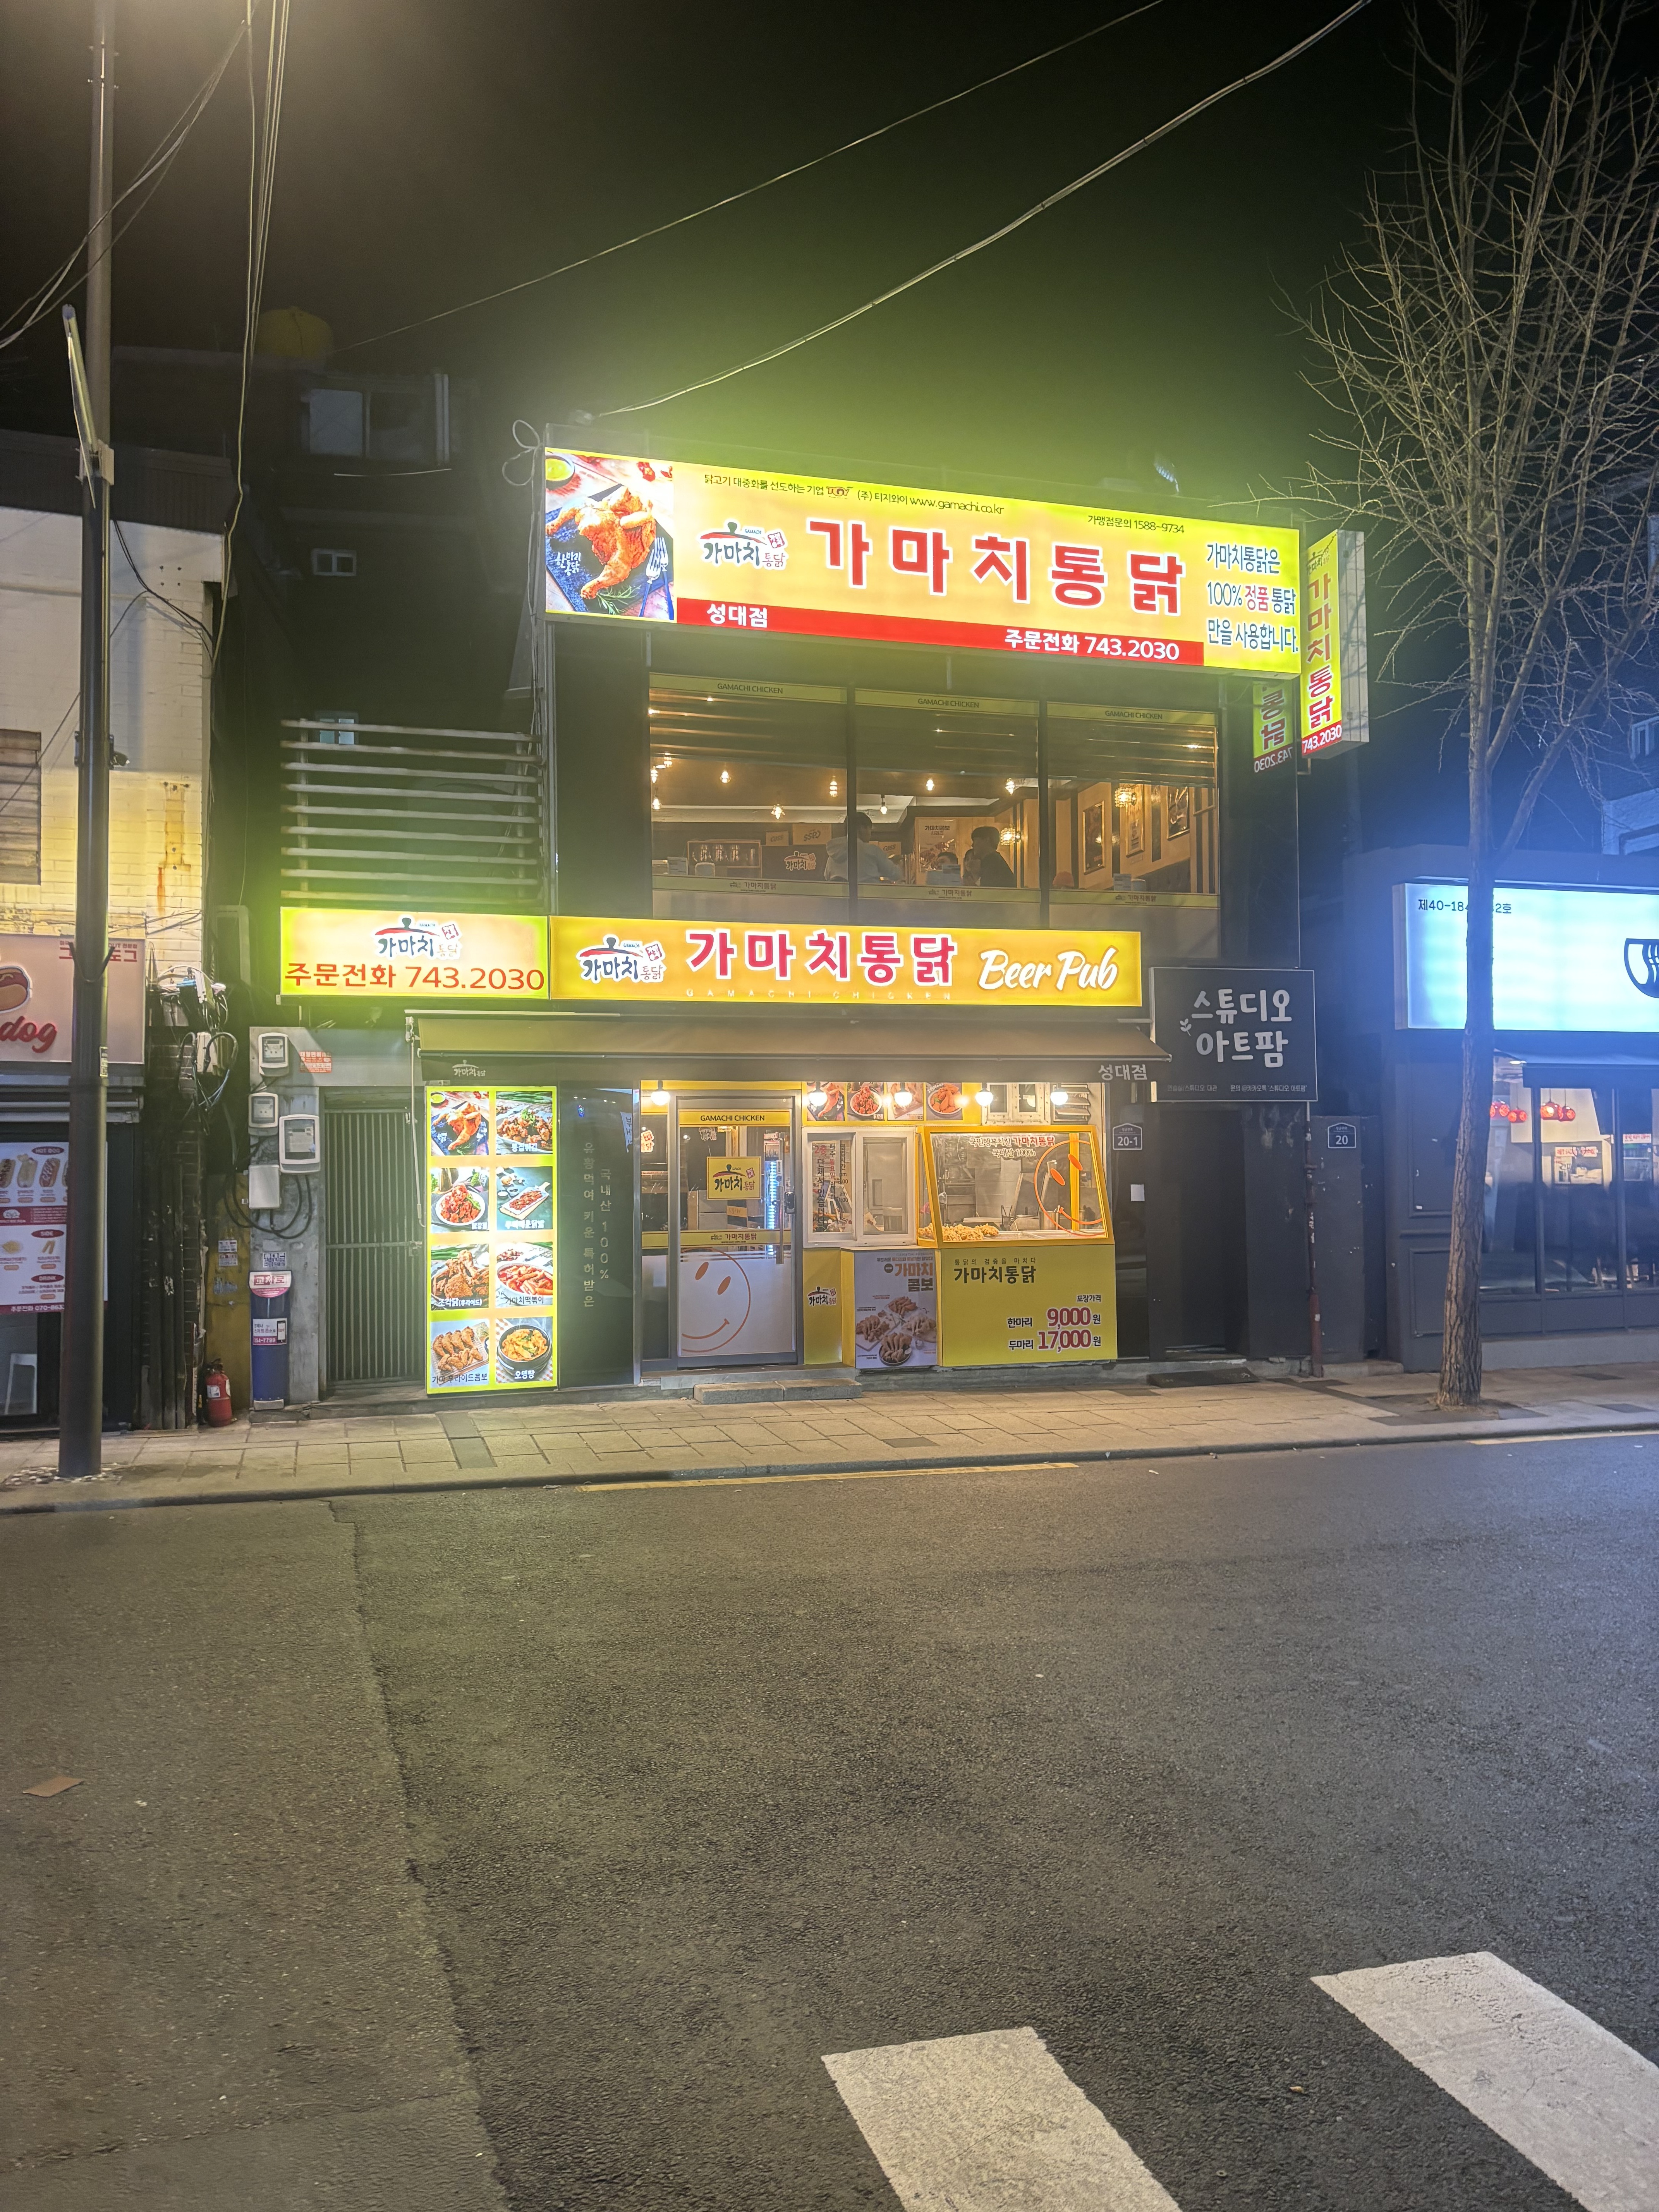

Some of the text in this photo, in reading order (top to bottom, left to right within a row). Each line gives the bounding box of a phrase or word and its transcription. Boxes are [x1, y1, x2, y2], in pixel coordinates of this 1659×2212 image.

[705, 474, 730, 486] 닭고기
[733, 477, 768, 489] 대중화를
[770, 481, 805, 494] 선도하는
[807, 486, 824, 495] 기업
[857, 490, 872, 501] (주)
[875, 493, 907, 505] 티지와이
[910, 497, 1004, 514] www.gamachi.co.kr
[1088, 514, 1185, 534] 가맹점문의 1588-9734
[704, 542, 786, 567] 가마치 통닭
[1207, 543, 1280, 574] 가마치통닭은
[810, 521, 1183, 613] 가마치통닭
[1207, 582, 1297, 615] 100% 정품 통닭
[706, 604, 768, 629] 성대점
[1005, 629, 1180, 661] 주문전화 743.2030
[1207, 620, 1299, 653] 만을 사용합니다.
[1307, 573, 1333, 729] 가마치통닭
[717, 683, 750, 691] GAMACHI
[1302, 725, 1342, 753] 743.2030
[744, 881, 776, 890] 가마치통닭
[942, 889, 972, 897] 가마치통닭
[378, 935, 434, 957] 가마치
[583, 956, 663, 981] 가마치 통닭
[689, 931, 955, 984] 가마치통닭
[285, 962, 544, 990] 주문전화 743.2030
[980, 948, 1118, 990] Beer Pub
[1192, 989, 1292, 1024] 스튜디오
[1196, 1030, 1288, 1068] 아트팜
[453, 1067, 476, 1077] 가마치
[1098, 1064, 1147, 1081] 성대점
[1013, 1137, 1055, 1146] 가마치통닭
[1118, 1136, 1137, 1146] 20-1
[1336, 1135, 1348, 1145] 20
[992, 1149, 1014, 1158] 국내산
[714, 1176, 755, 1192] 가마치 통닭
[600, 1169, 611, 1279] 국내산 100%
[254, 1275, 285, 1285] 교차로
[895, 1262, 933, 1277] 가마치
[954, 1266, 1036, 1284] 가마치통닭
[908, 1278, 933, 1292] 콤보
[809, 1295, 828, 1306] 가마치
[1077, 1295, 1101, 1303] 포장가격
[1007, 1307, 1101, 1329] 한마리 9,000 원
[1009, 1329, 1101, 1352] 두마리 17,000 원
[514, 1370, 536, 1379] 오뎅탕
